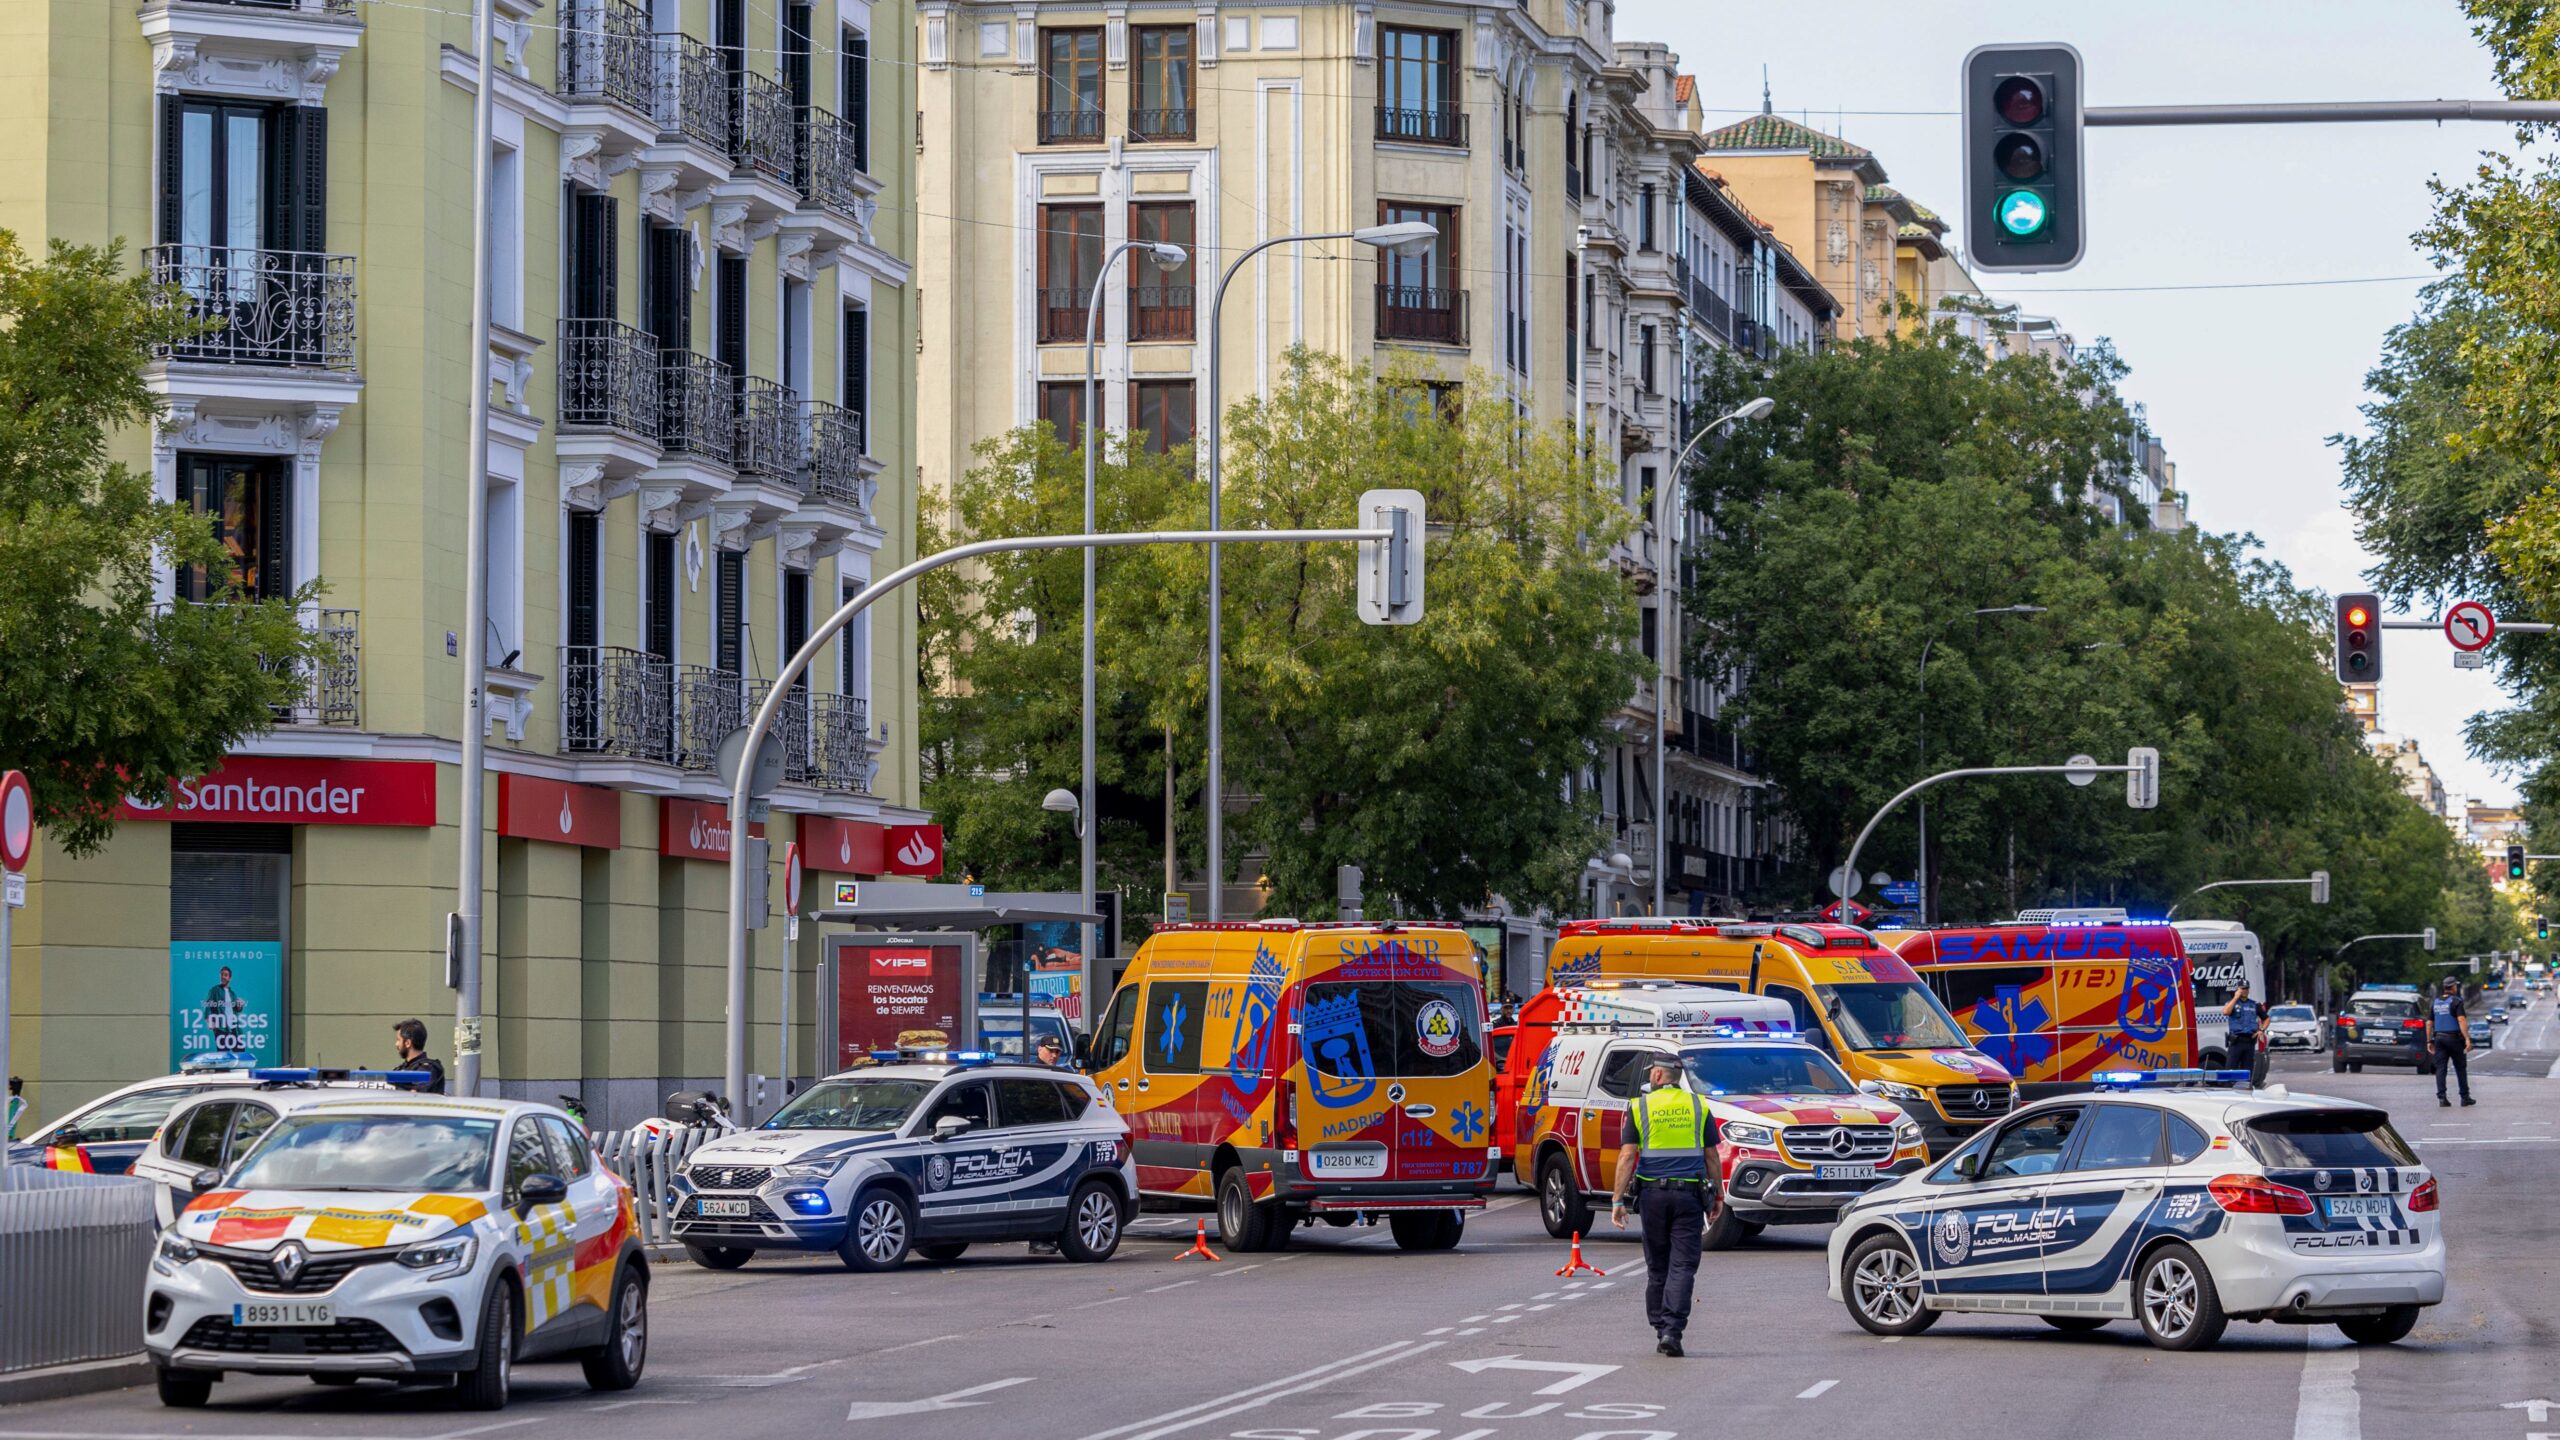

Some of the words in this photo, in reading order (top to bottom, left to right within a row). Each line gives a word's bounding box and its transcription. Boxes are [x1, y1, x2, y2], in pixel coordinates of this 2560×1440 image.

[177, 776, 365, 814] Santander
[702, 819, 731, 852] Santan
[971, 887, 983, 896] 215
[1340, 939, 1442, 966] SAMUR
[1939, 931, 2128, 963] SAMUR
[2188, 942, 2228, 951] ACCIDENTES
[184, 951, 263, 960] BIENESTANDO
[875, 959, 927, 967] VIPS
[1413, 967, 1443, 977] CIVIL
[1706, 967, 1749, 977] AMBULANCIA
[867, 985, 934, 993] REINVENTAMOS
[2206, 979, 2239, 988] MUNICIP
[873, 995, 888, 1004] los
[889, 995, 928, 1004] bocatas
[876, 1006, 889, 1015] de
[891, 1006, 925, 1015] SIEMPRE
[1667, 1010, 1694, 1023] Selur
[180, 1008, 203, 1029] 12
[208, 1012, 269, 1029] meses
[182, 1029, 210, 1050] sin
[2096, 1032, 2169, 1070] MADRID
[1220, 1087, 1254, 1130] MADRID
[1652, 1106, 1691, 1117] POLICÍA
[1148, 1111, 1183, 1136] SAMUR
[1322, 1111, 1386, 1139] MADRID
[1653, 1116, 1692, 1124] MUNICIPAL
[1096, 1140, 1113, 1152] 092
[1096, 1152, 1111, 1163] 112
[1323, 1155, 1352, 1167] 0280
[1355, 1155, 1376, 1167] MCZ
[985, 1167, 1019, 1177] MADRID
[1452, 1161, 1484, 1175] 8787
[1822, 1167, 1849, 1178] 2511
[1852, 1167, 1873, 1178] LKX
[2405, 1172, 2420, 1185] 4280
[2169, 1194, 2195, 1207] 092
[703, 1202, 726, 1214] 5624
[728, 1202, 747, 1214] MCD
[2164, 1207, 2186, 1219] 112
[2333, 1200, 2363, 1214] 5246
[2366, 1200, 2388, 1214] MDH
[2013, 1230, 2057, 1243] MADRID
[247, 1305, 289, 1322] 8931
[296, 1305, 329, 1322] LYG
[1331, 1402, 1667, 1420] BUS
